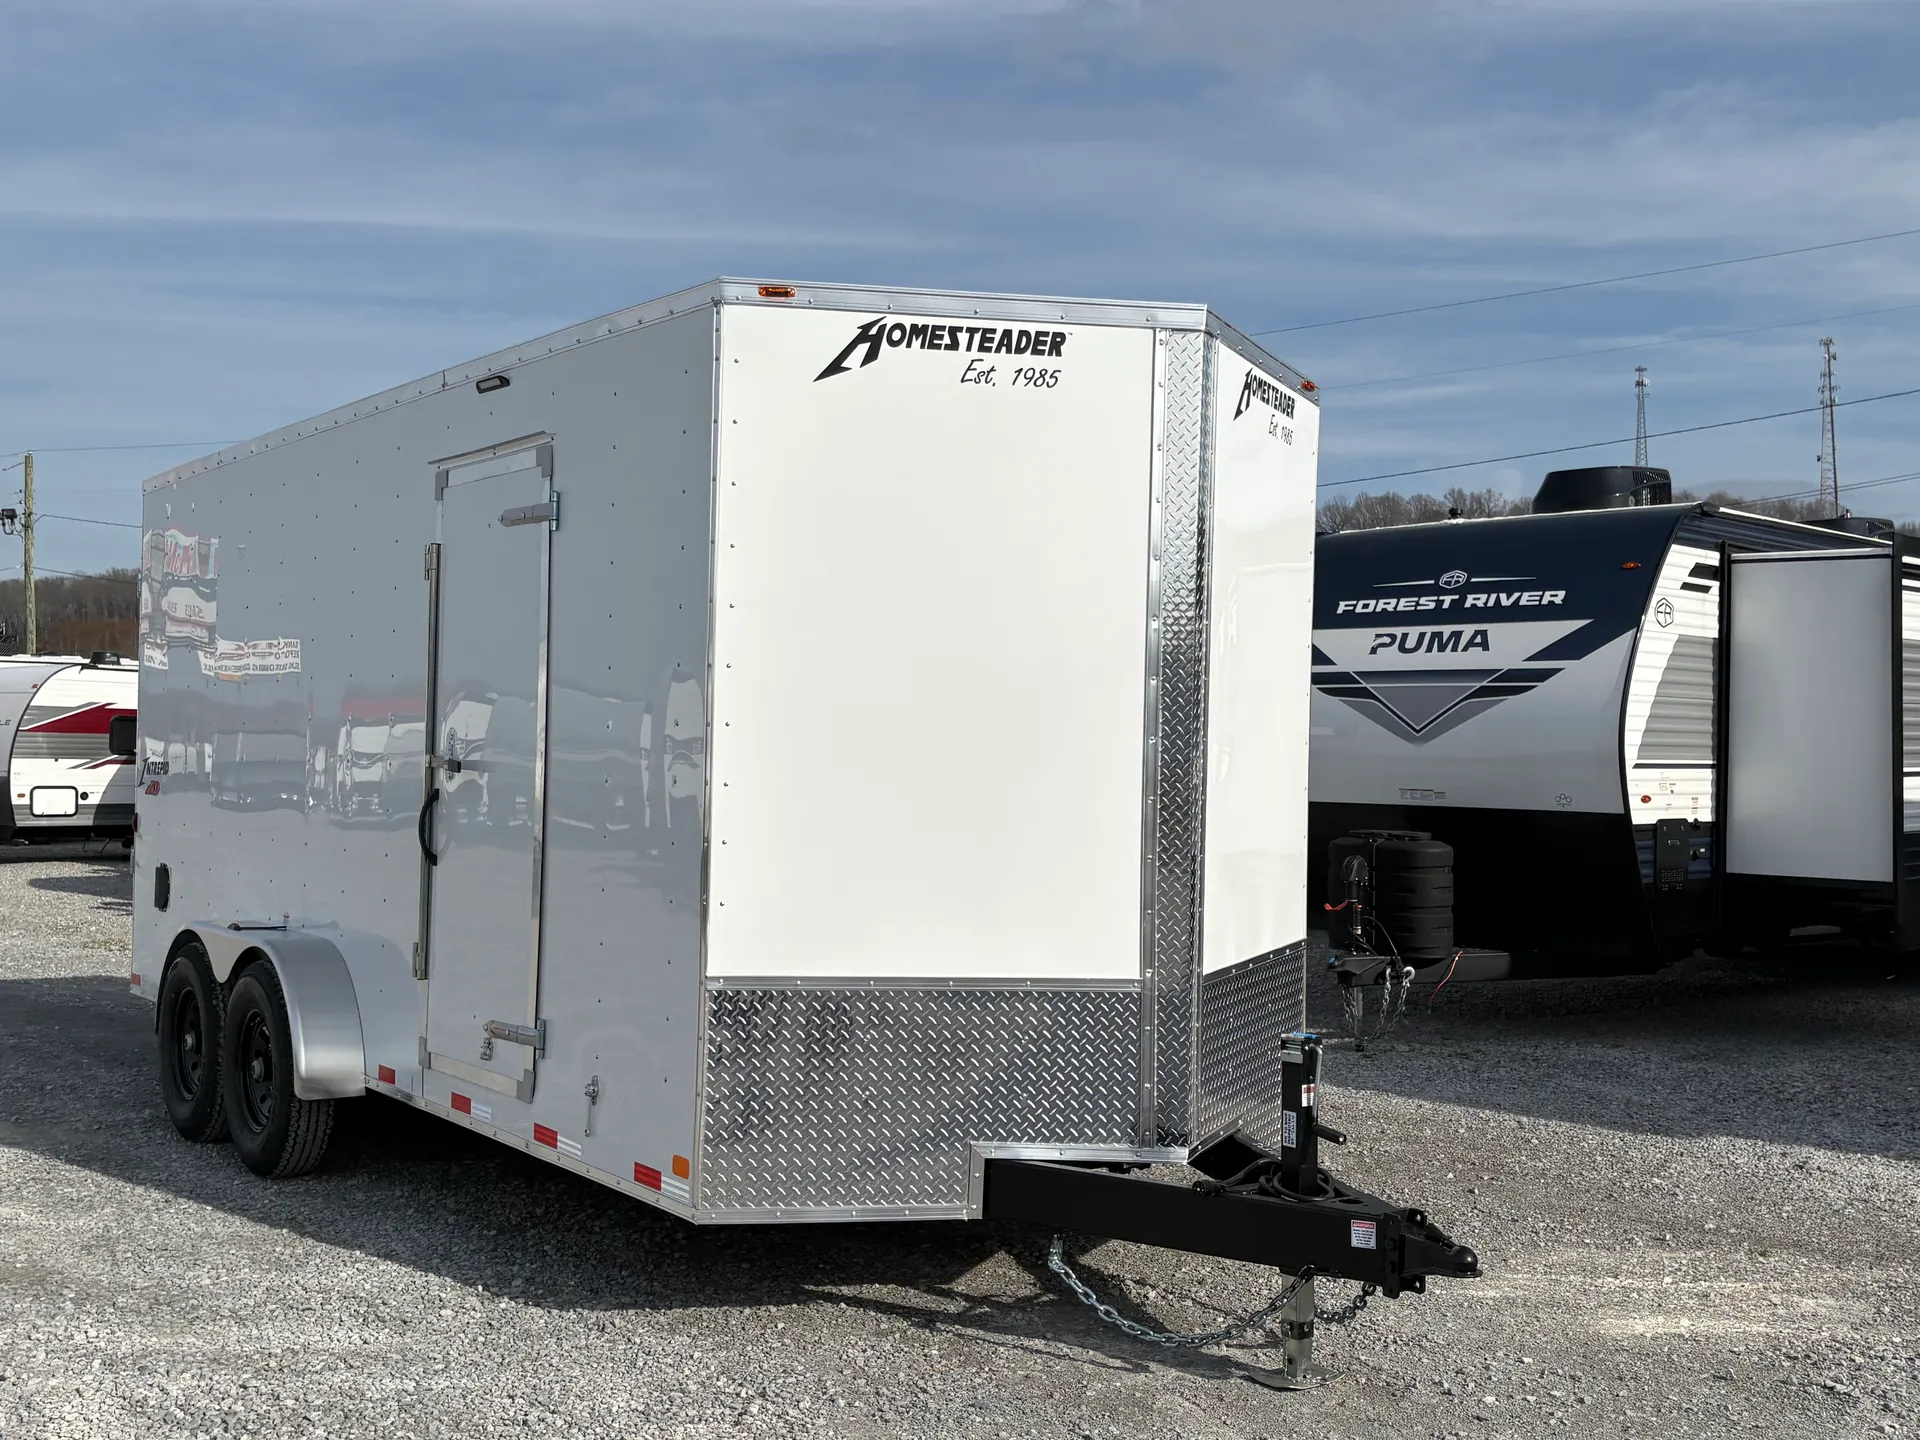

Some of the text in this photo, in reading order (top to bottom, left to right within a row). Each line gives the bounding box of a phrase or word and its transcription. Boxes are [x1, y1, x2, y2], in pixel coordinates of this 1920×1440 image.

[813, 316, 1067, 382] HOMESTEADER
[960, 358, 1062, 388] Est. 1985
[1233, 367, 1295, 421] HOMESTEADER
[1336, 590, 1567, 615] FOREST RIVER
[1368, 629, 1491, 656] PUMA
